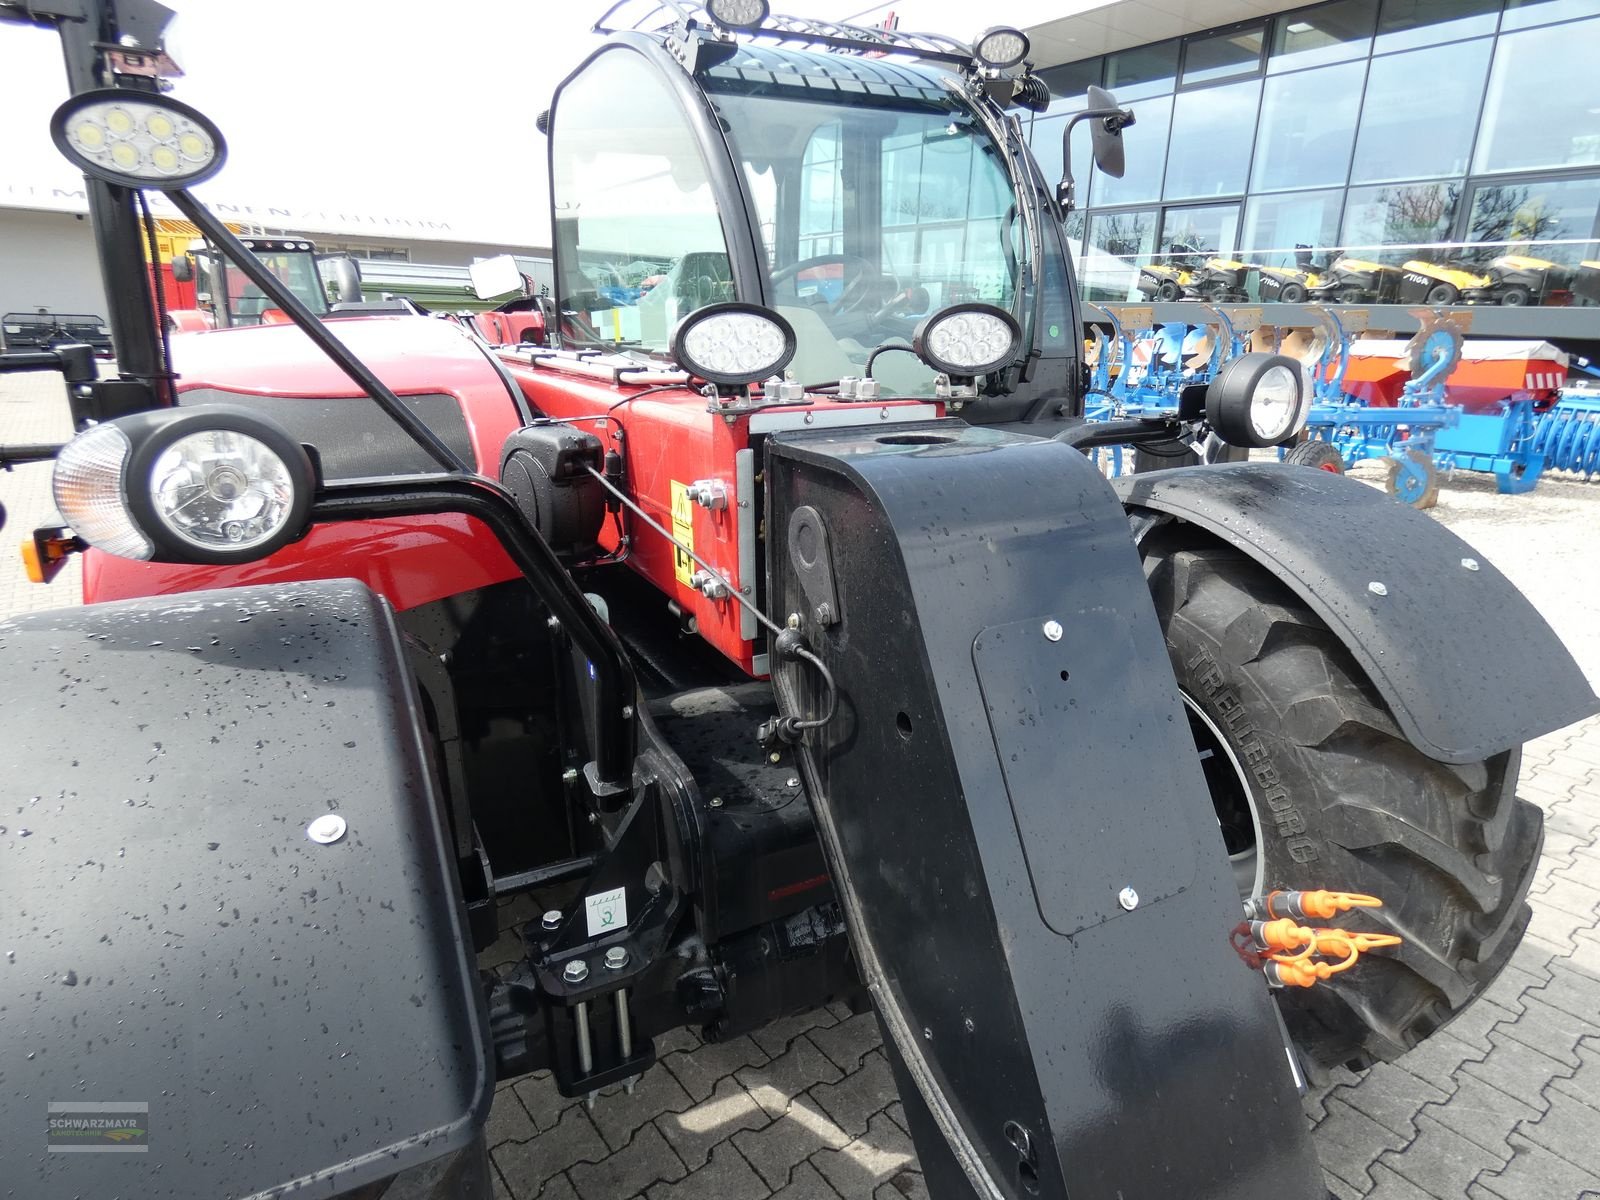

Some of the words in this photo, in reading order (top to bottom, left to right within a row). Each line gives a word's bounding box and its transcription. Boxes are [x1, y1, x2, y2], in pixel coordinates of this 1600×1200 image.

[1260, 277, 1280, 288] STIGA
[1403, 273, 1429, 286] STIGA
[1187, 641, 1320, 864] TRELLEBORG
